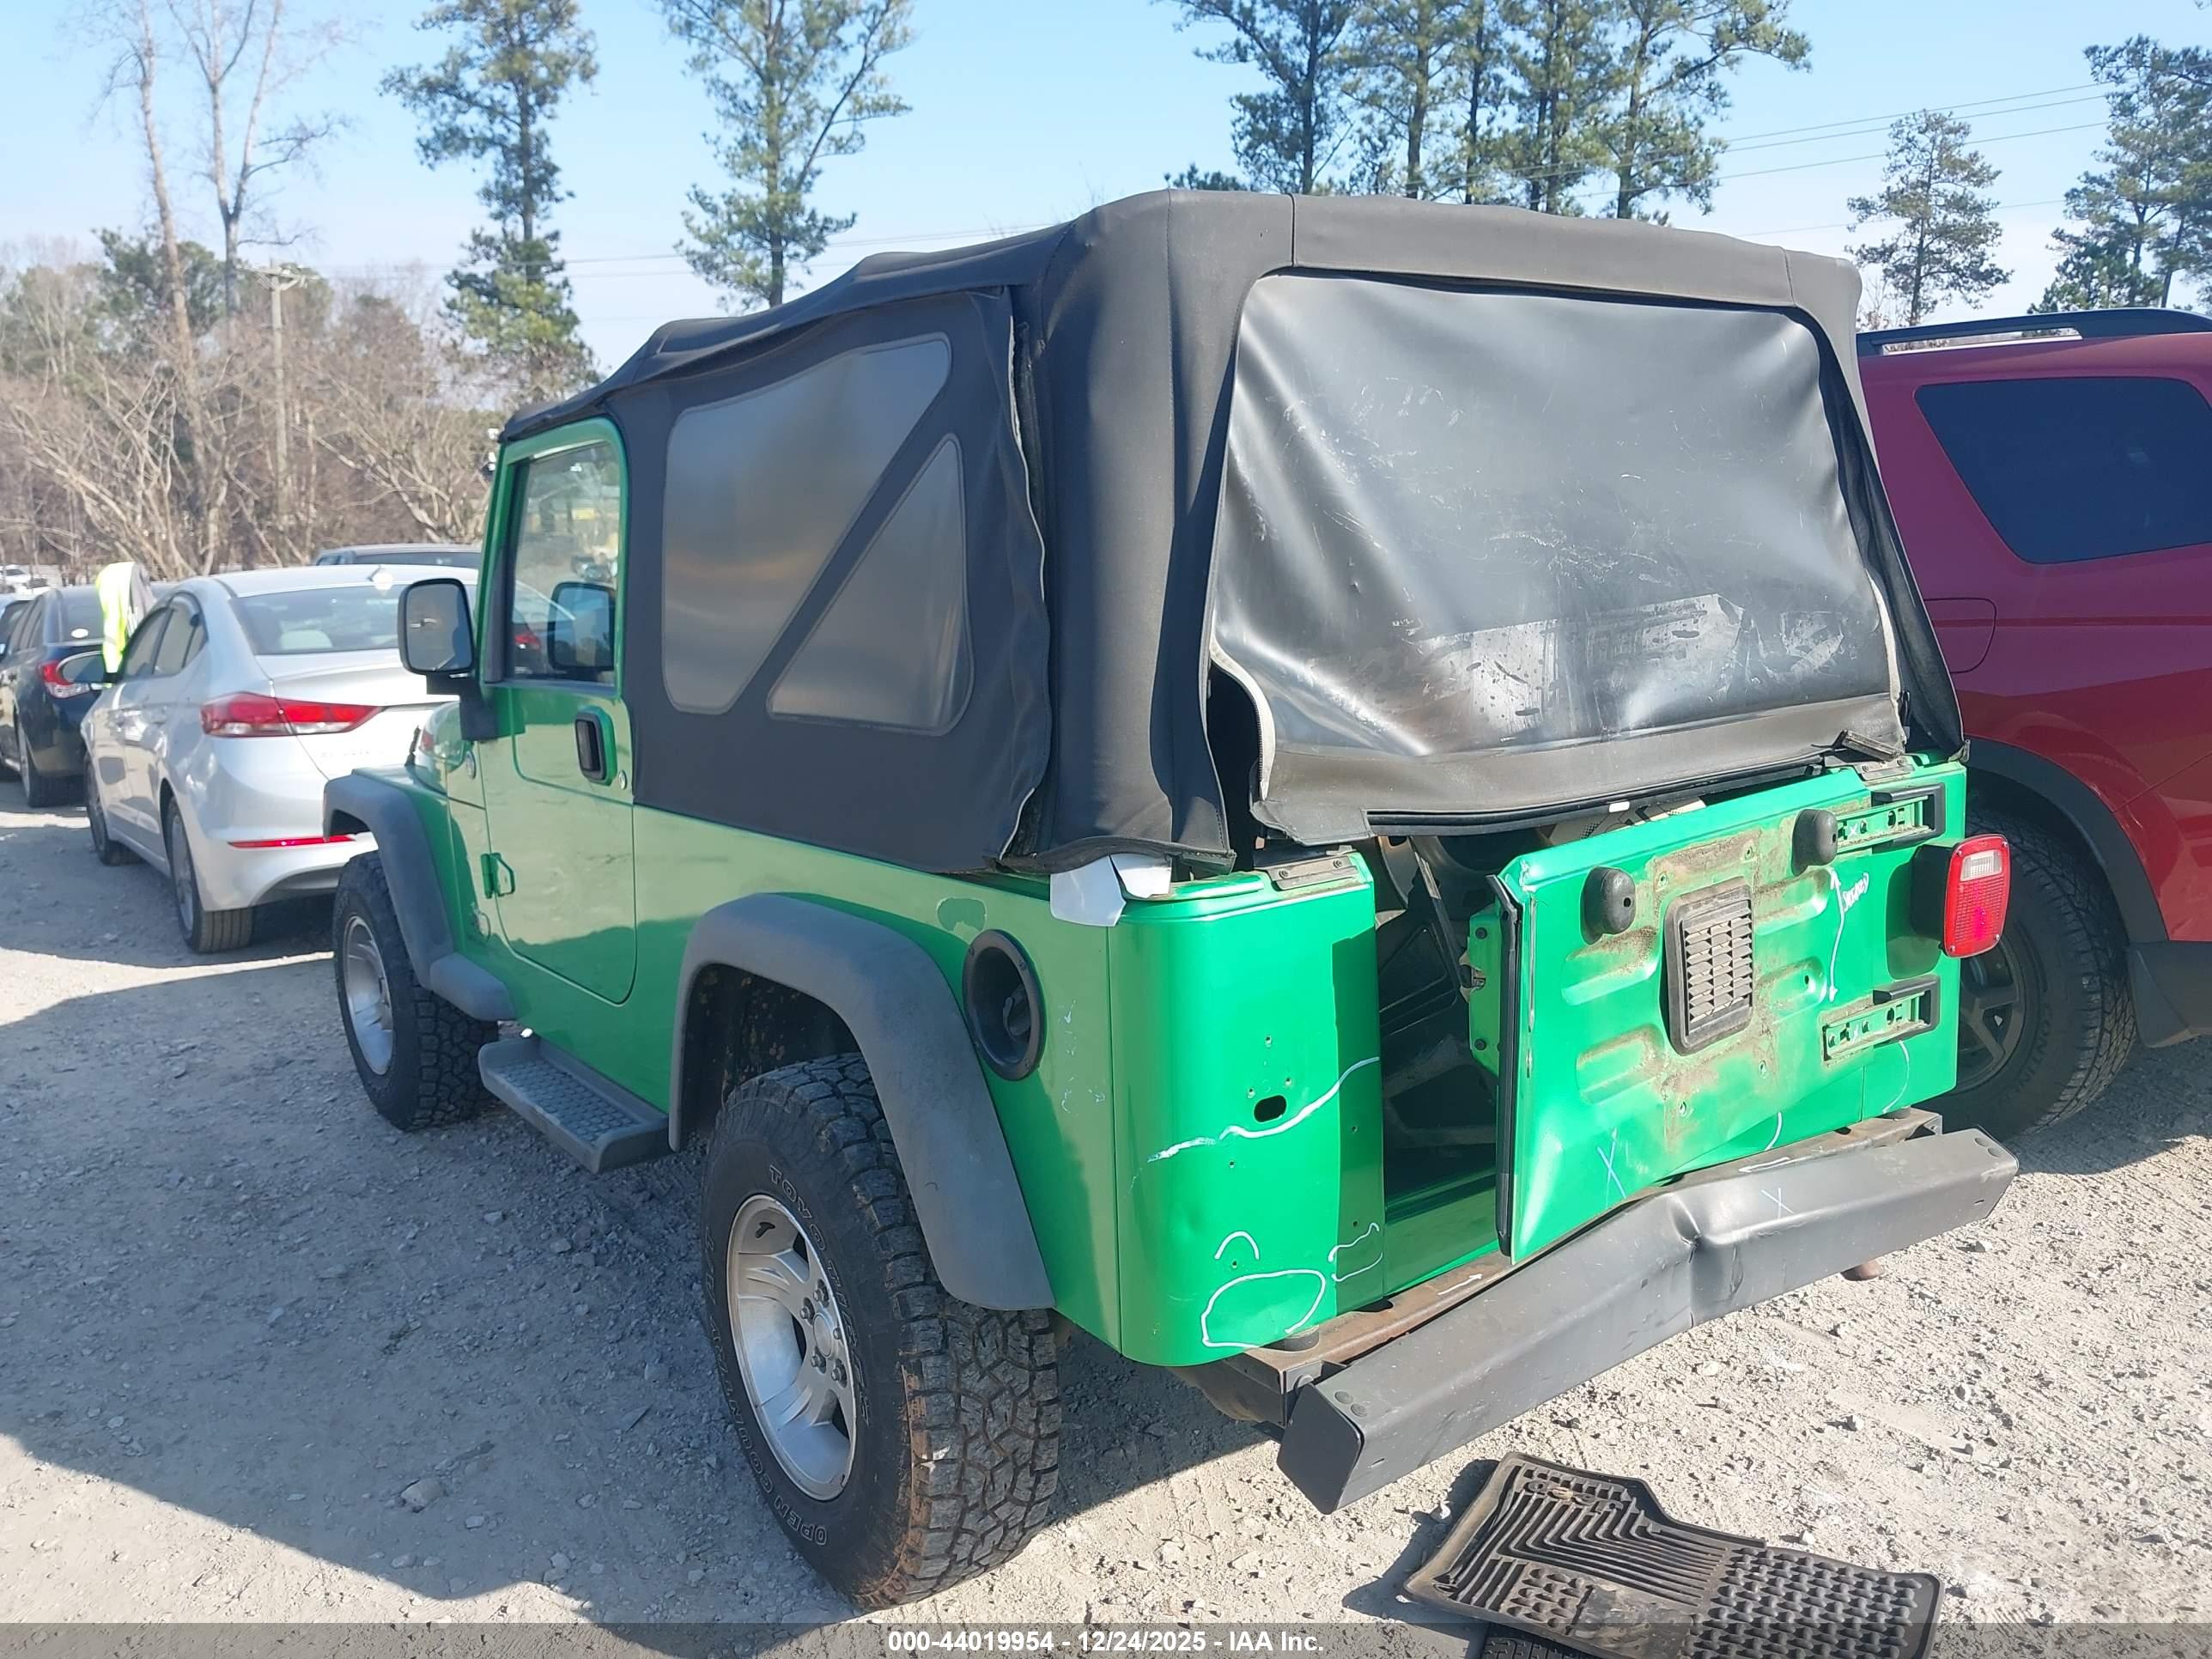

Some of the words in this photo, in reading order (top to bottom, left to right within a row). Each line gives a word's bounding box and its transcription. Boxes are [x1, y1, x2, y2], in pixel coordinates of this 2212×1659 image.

[769, 1164, 825, 1251] TOYO
[827, 1260, 871, 1427] TIRES
[709, 1315, 773, 1494] COUNTRY
[774, 1493, 828, 1547] OPEN
